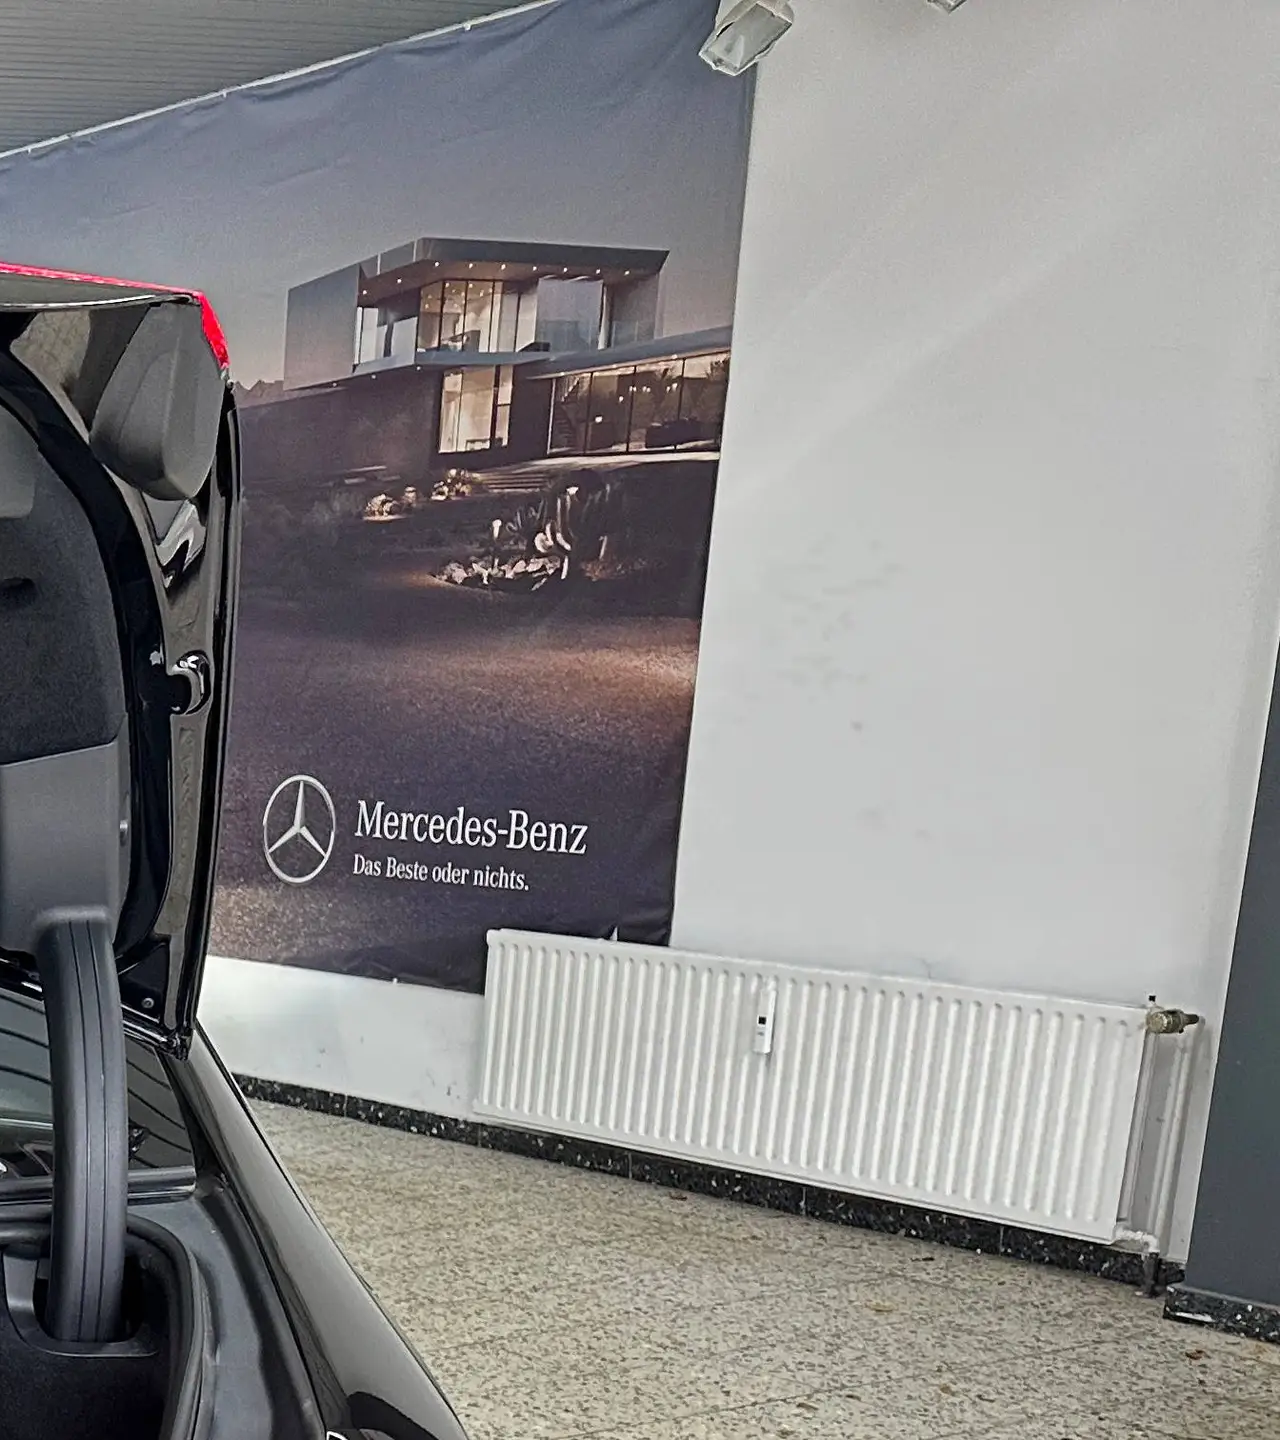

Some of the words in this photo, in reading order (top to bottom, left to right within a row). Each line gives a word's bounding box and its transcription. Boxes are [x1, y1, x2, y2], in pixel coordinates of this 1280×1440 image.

[354, 799, 589, 855] Mercedes-Benz
[353, 853, 382, 877] Das
[385, 856, 428, 881] Beste
[432, 862, 470, 886] oder
[472, 866, 530, 891] nichts.
